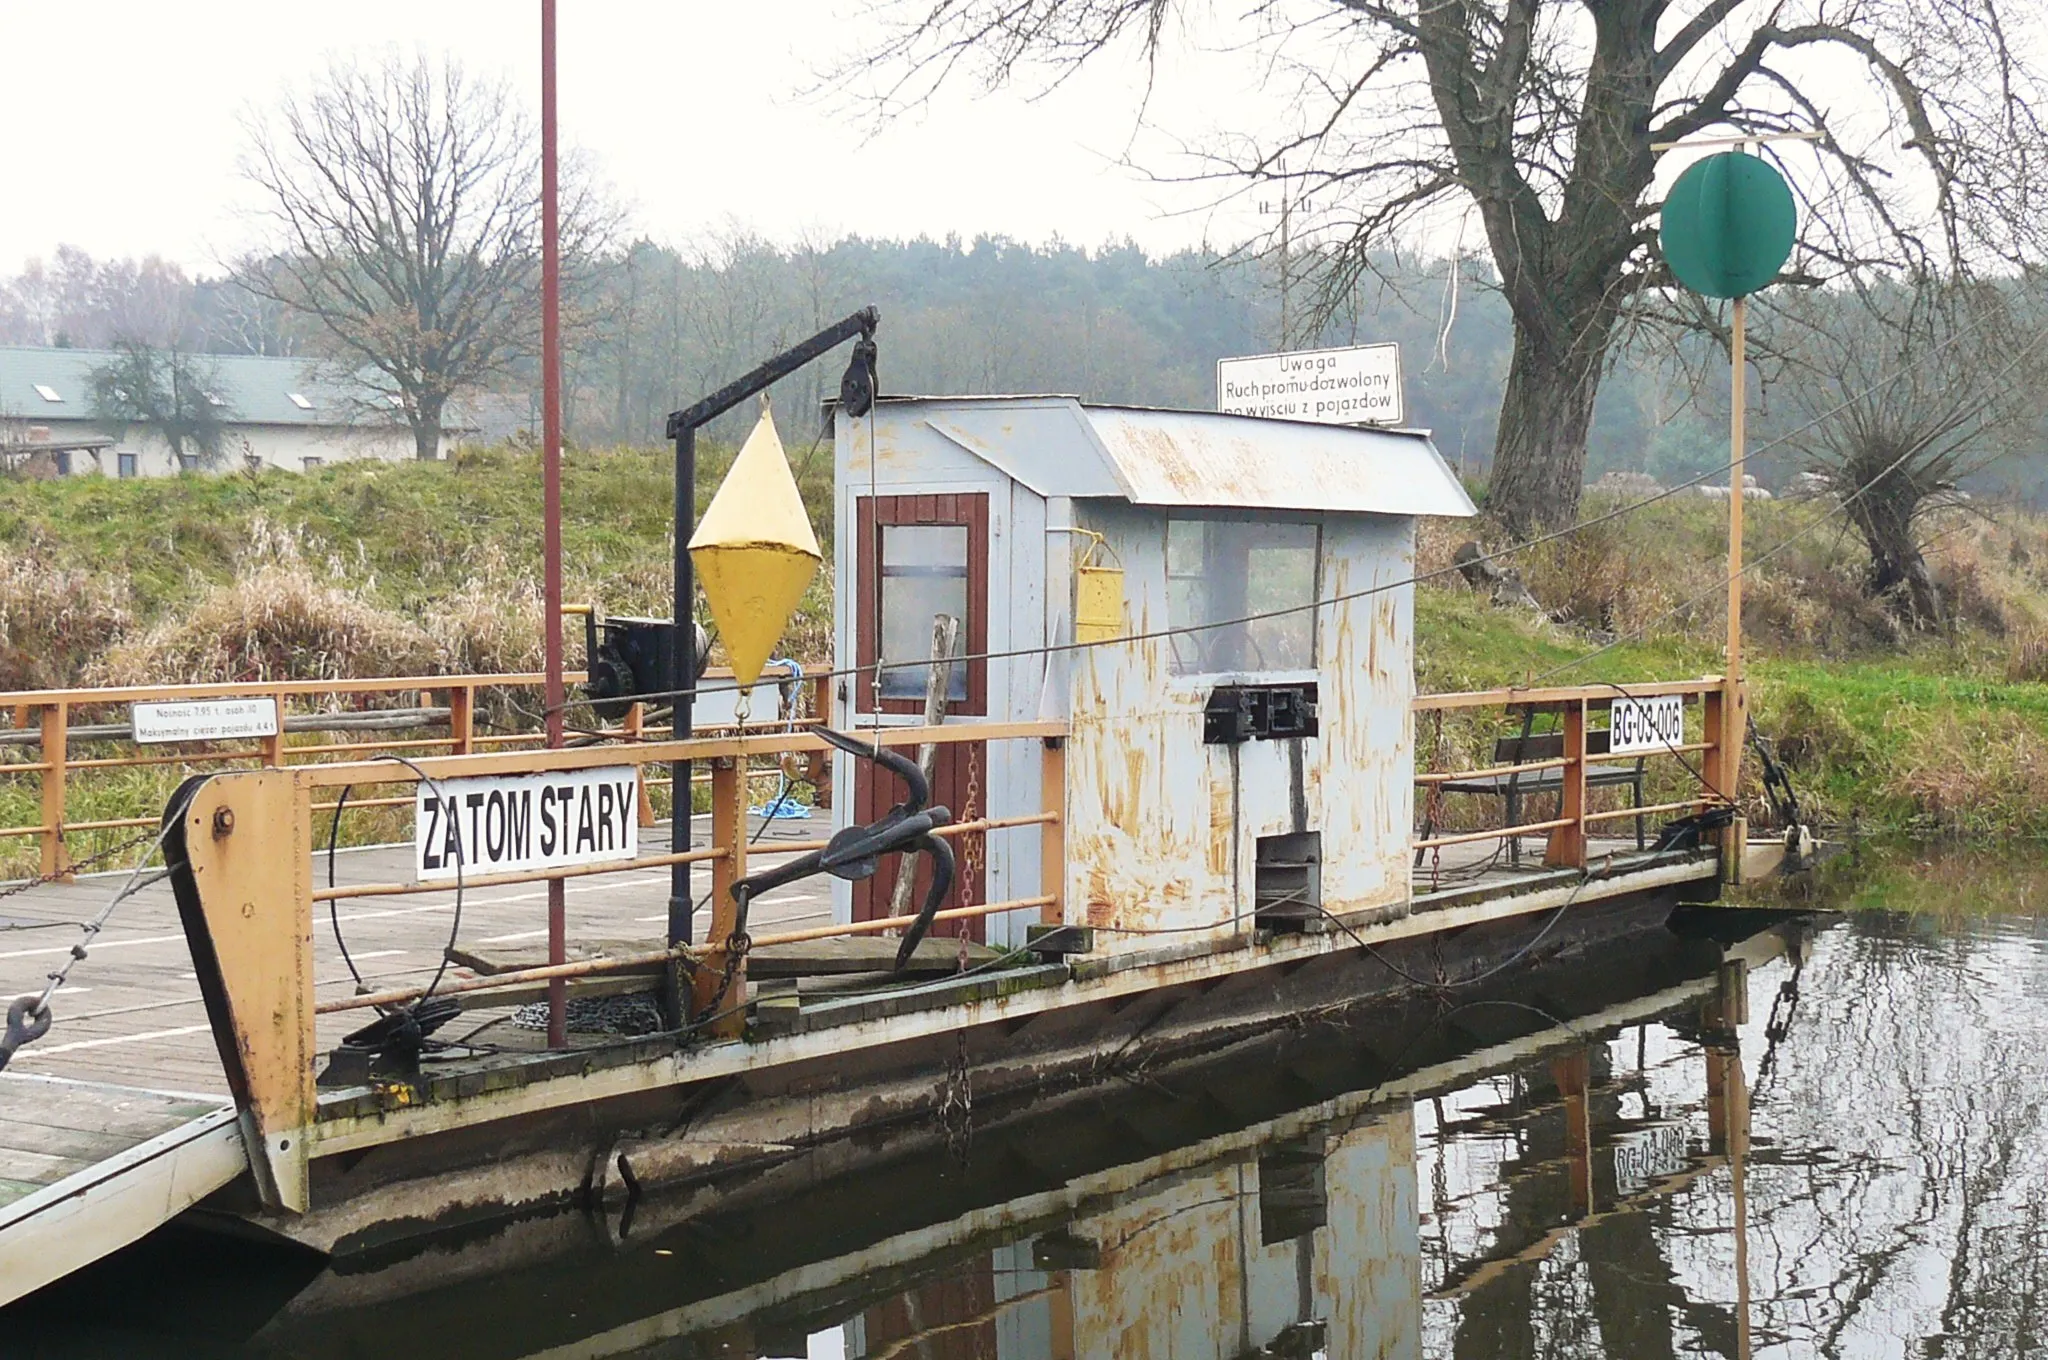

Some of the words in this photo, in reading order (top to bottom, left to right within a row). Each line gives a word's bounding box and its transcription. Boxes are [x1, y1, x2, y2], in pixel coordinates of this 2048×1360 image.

[1280, 357, 1336, 374] Uwaga
[1226, 381, 1259, 398] Ruch
[1262, 381, 1307, 400] promu
[1310, 371, 1390, 391] dozwolony
[1303, 402, 1308, 413] z
[1614, 702, 1679, 746] BG-03-006
[423, 789, 531, 870] ZATOM
[540, 781, 634, 857] STARY
